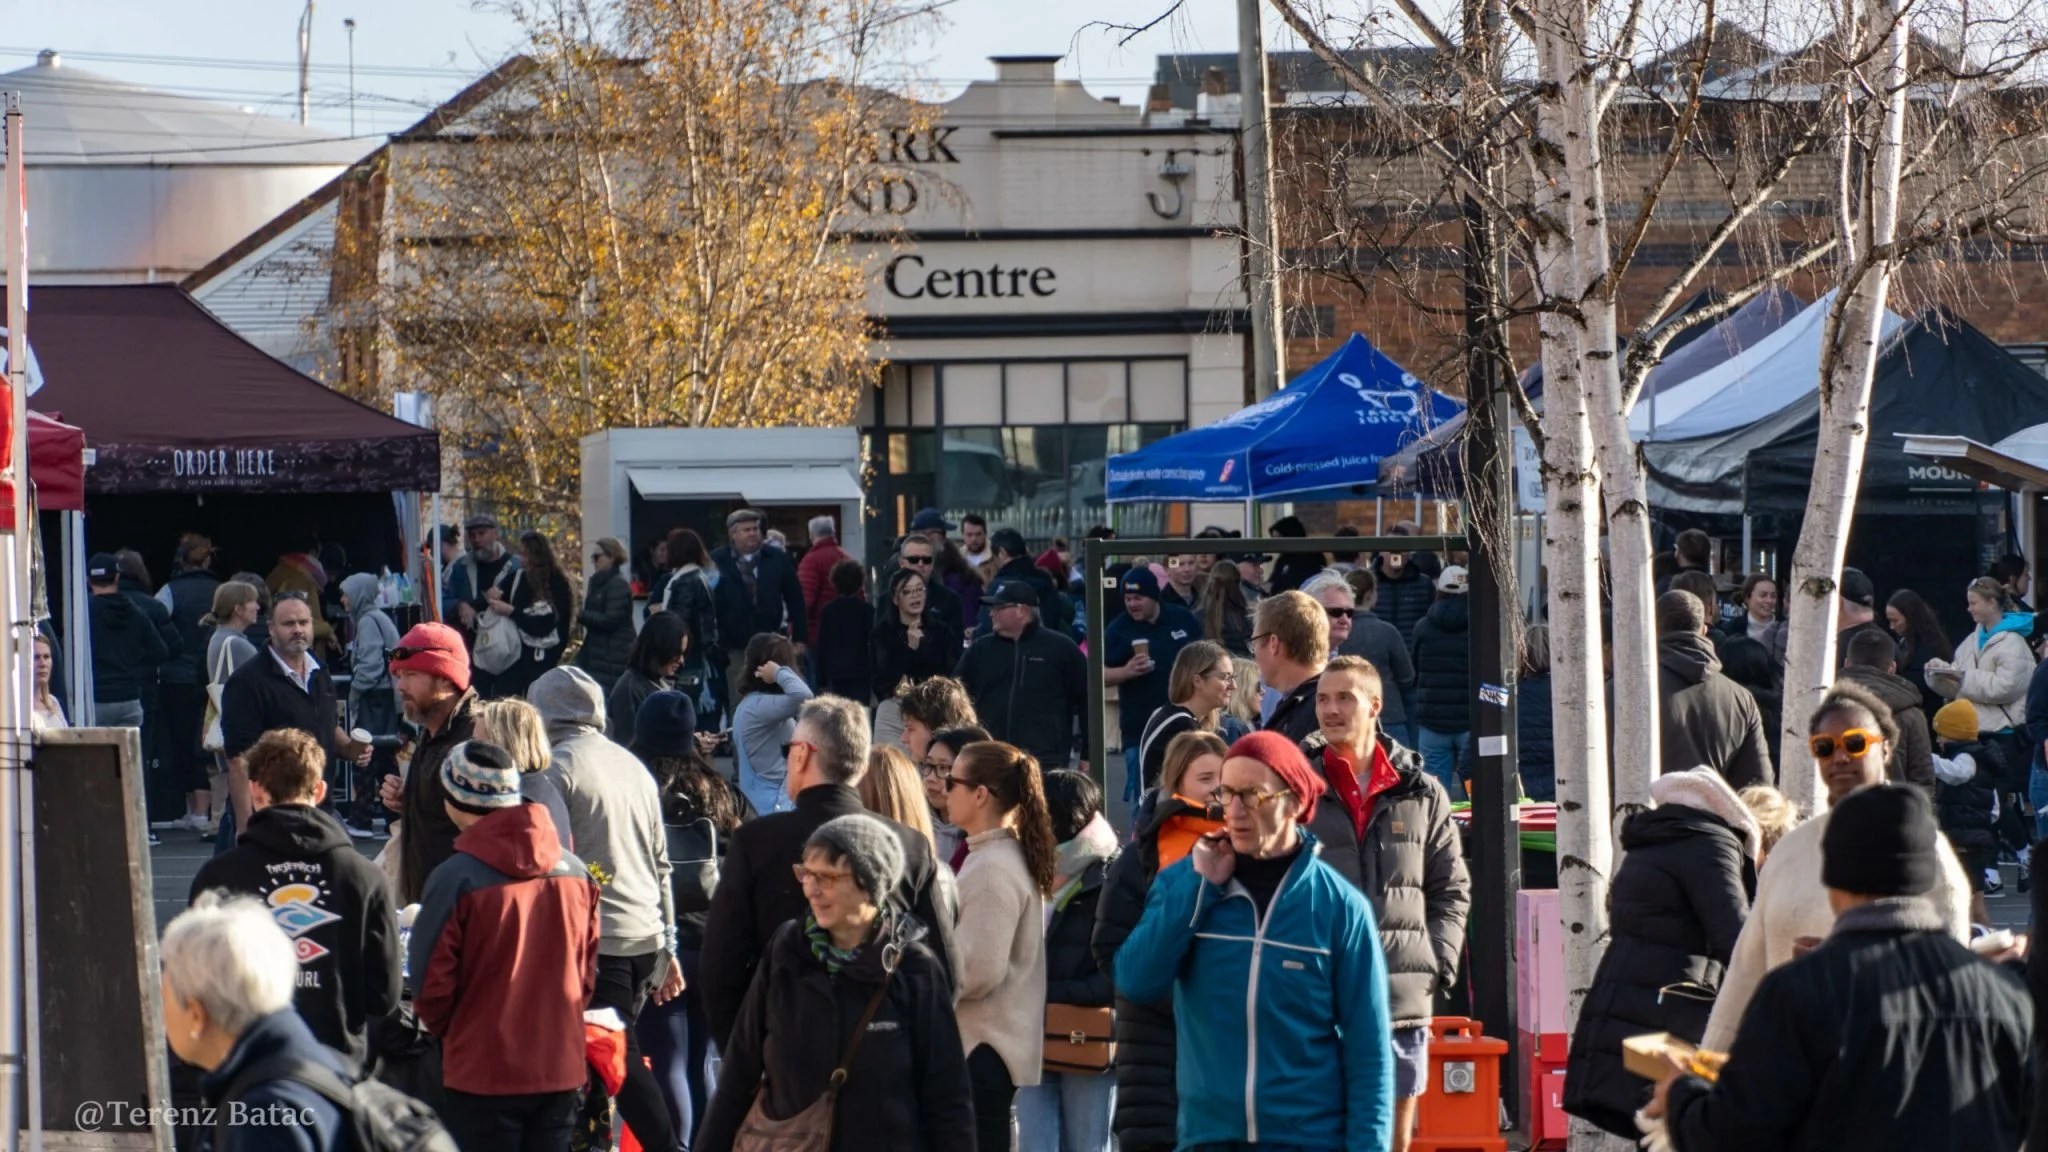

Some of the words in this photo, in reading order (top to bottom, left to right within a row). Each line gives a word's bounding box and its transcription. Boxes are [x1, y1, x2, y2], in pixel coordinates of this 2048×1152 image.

[866, 126, 961, 163] RK
[846, 177, 918, 216] ND
[884, 254, 1057, 300] Centre
[174, 450, 228, 476] ORDER
[236, 449, 276, 476] HERE
[1265, 457, 1340, 476] Cold-pressed
[1341, 455, 1369, 468] juice
[295, 971, 322, 988] URL
